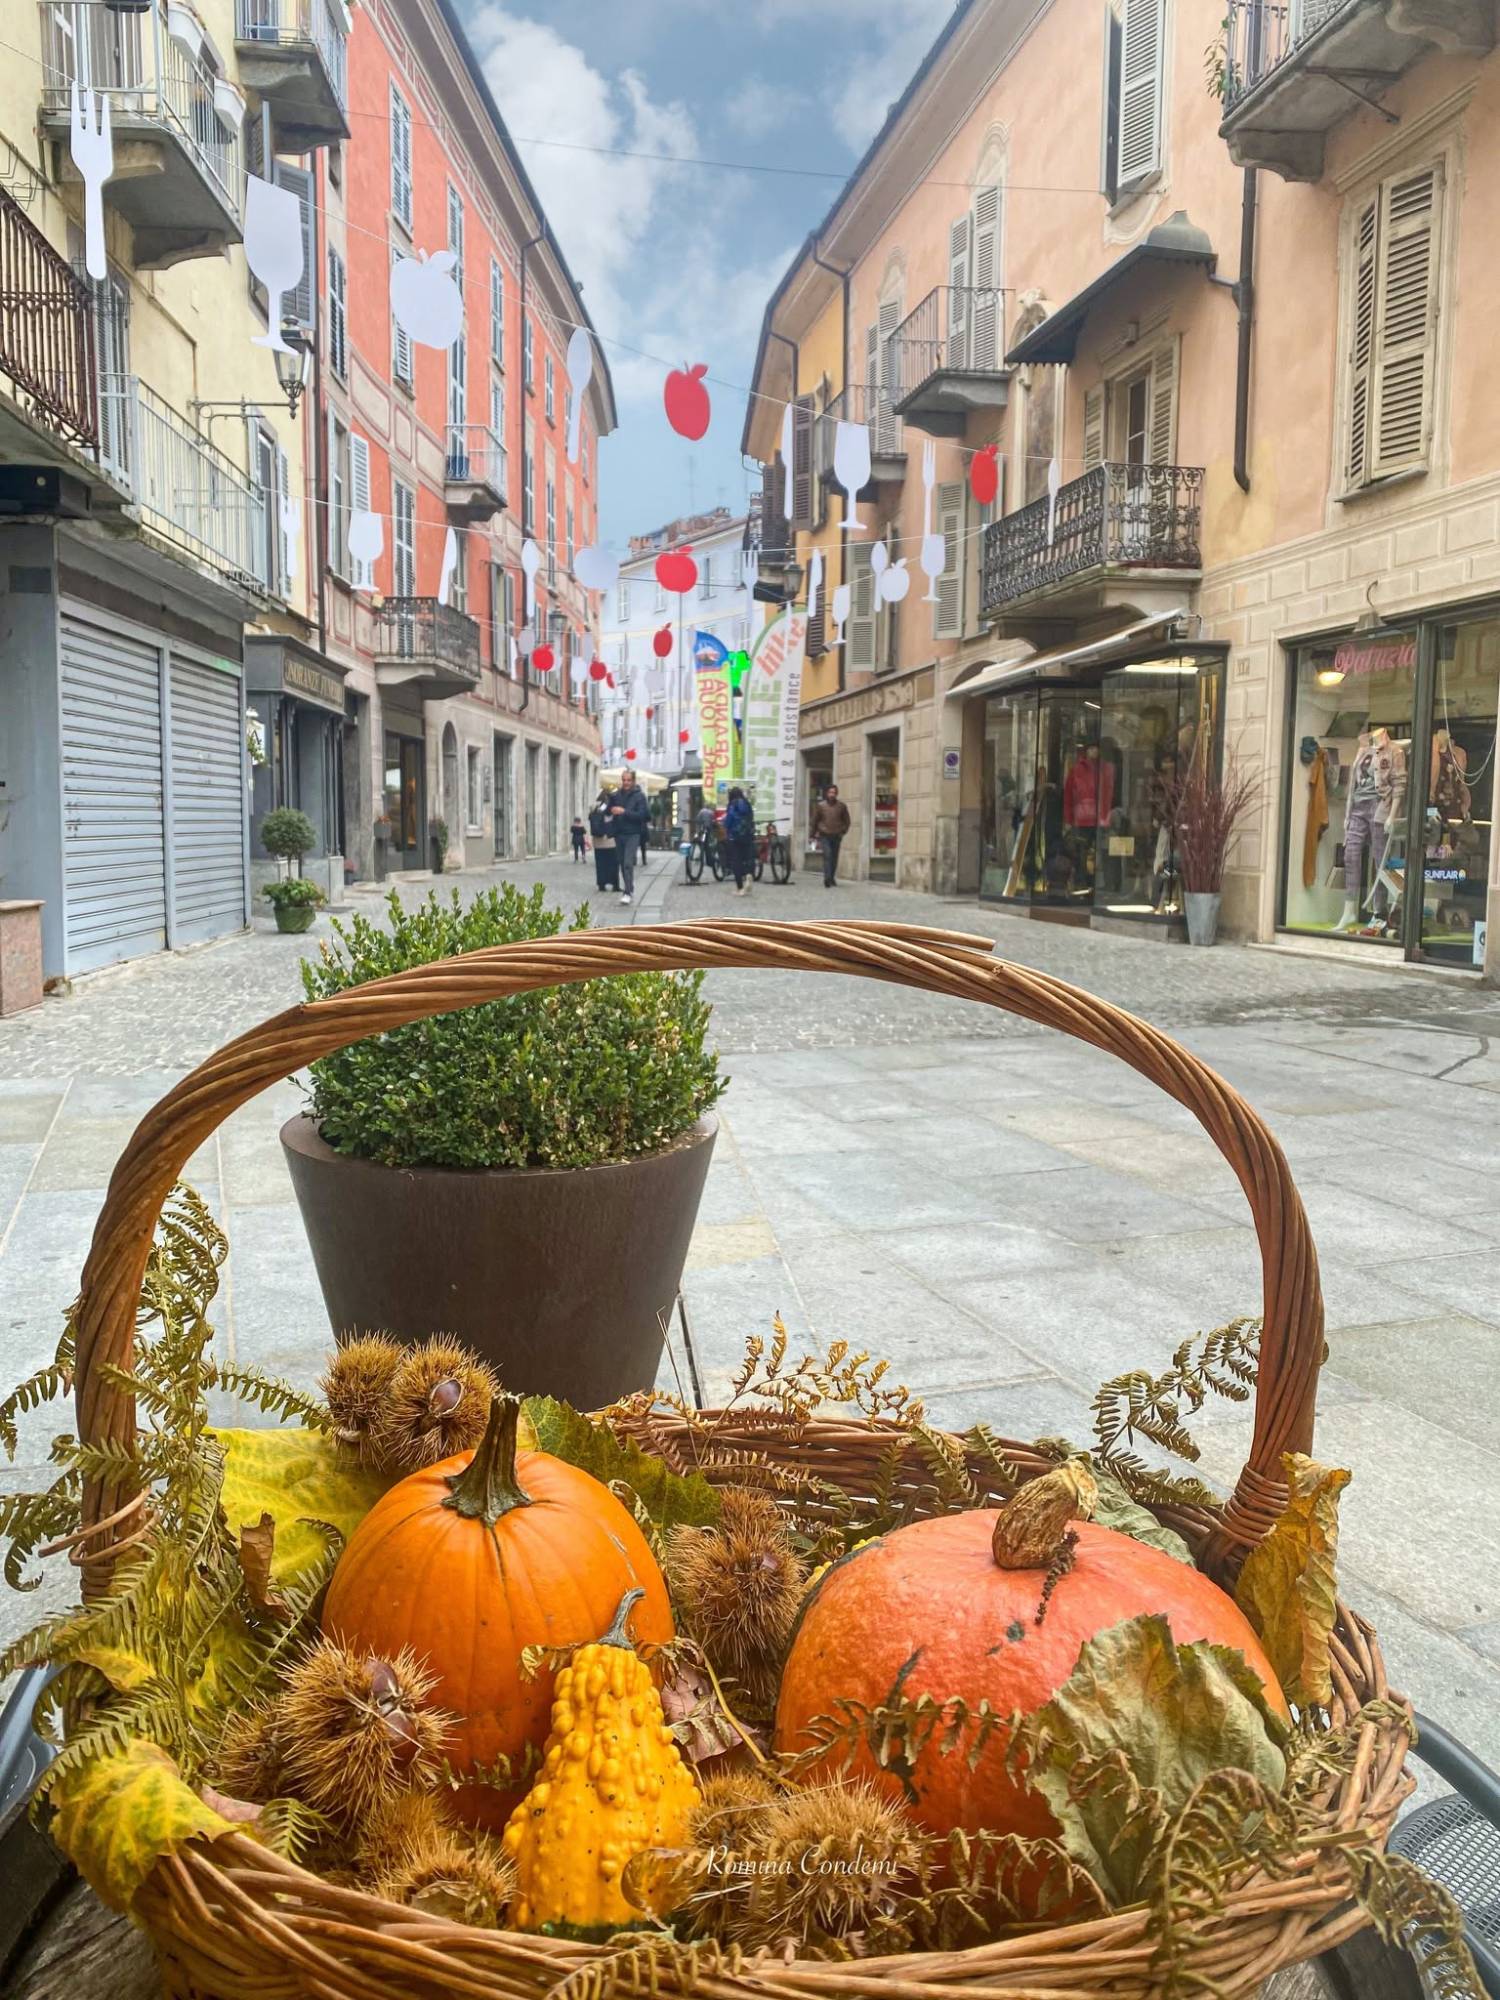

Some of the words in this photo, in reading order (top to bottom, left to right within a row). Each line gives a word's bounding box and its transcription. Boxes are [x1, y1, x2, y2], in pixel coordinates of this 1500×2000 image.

[783, 673, 801, 750] assistance
[782, 777, 794, 806] rent
[1424, 869, 1458, 880] SUNFLAIR
